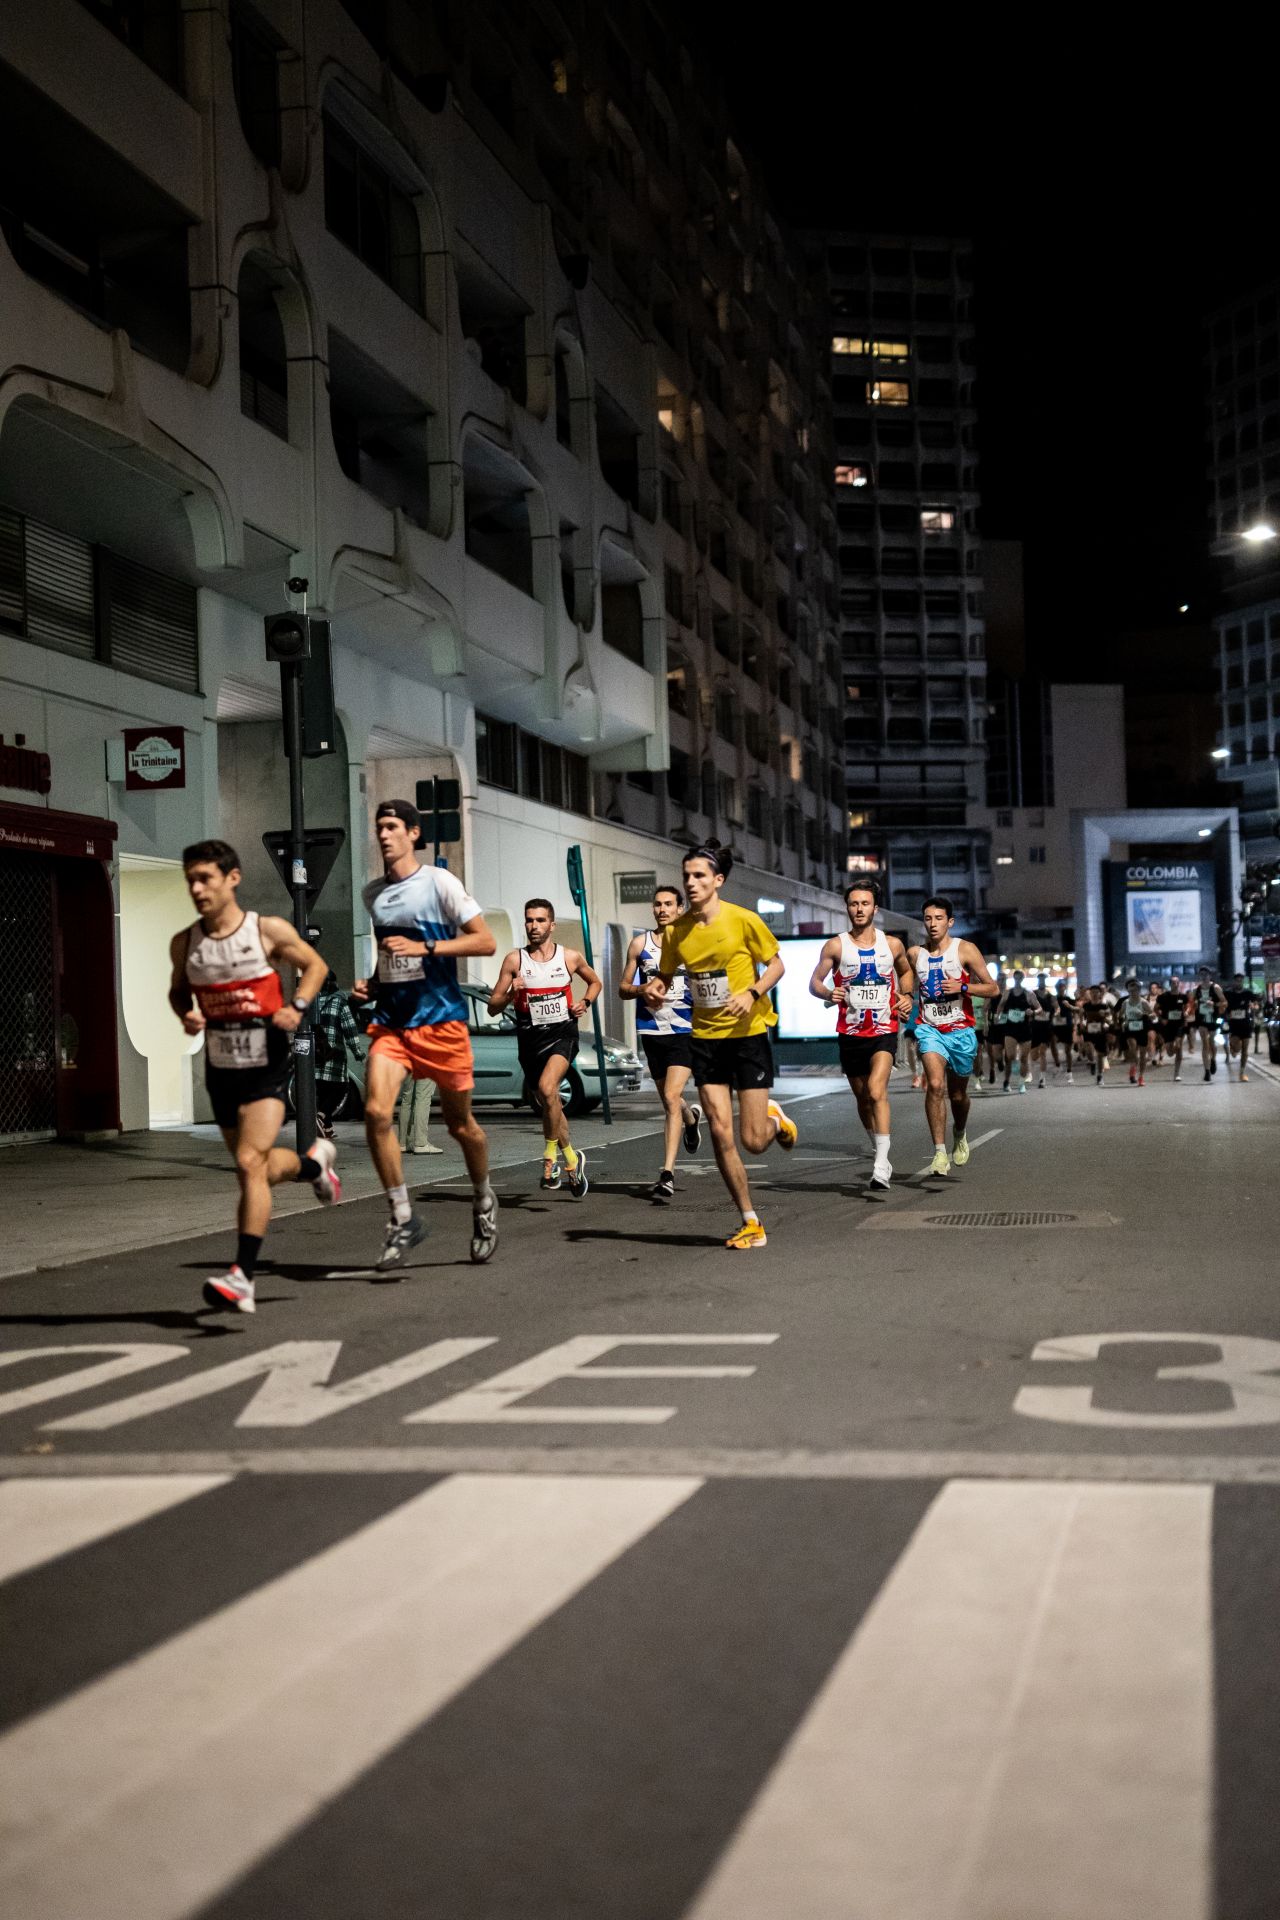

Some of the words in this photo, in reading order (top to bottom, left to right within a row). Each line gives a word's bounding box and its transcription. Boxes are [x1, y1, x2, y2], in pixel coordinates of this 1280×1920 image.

[132, 754, 139, 767] la
[142, 756, 178, 767] trinitaine
[1126, 866, 1199, 880] COLOMBIA
[860, 989, 879, 1001] 7157
[539, 1002, 561, 1016] 7039
[932, 1005, 953, 1017] 8634
[1013, 1332, 1280, 1429] 3
